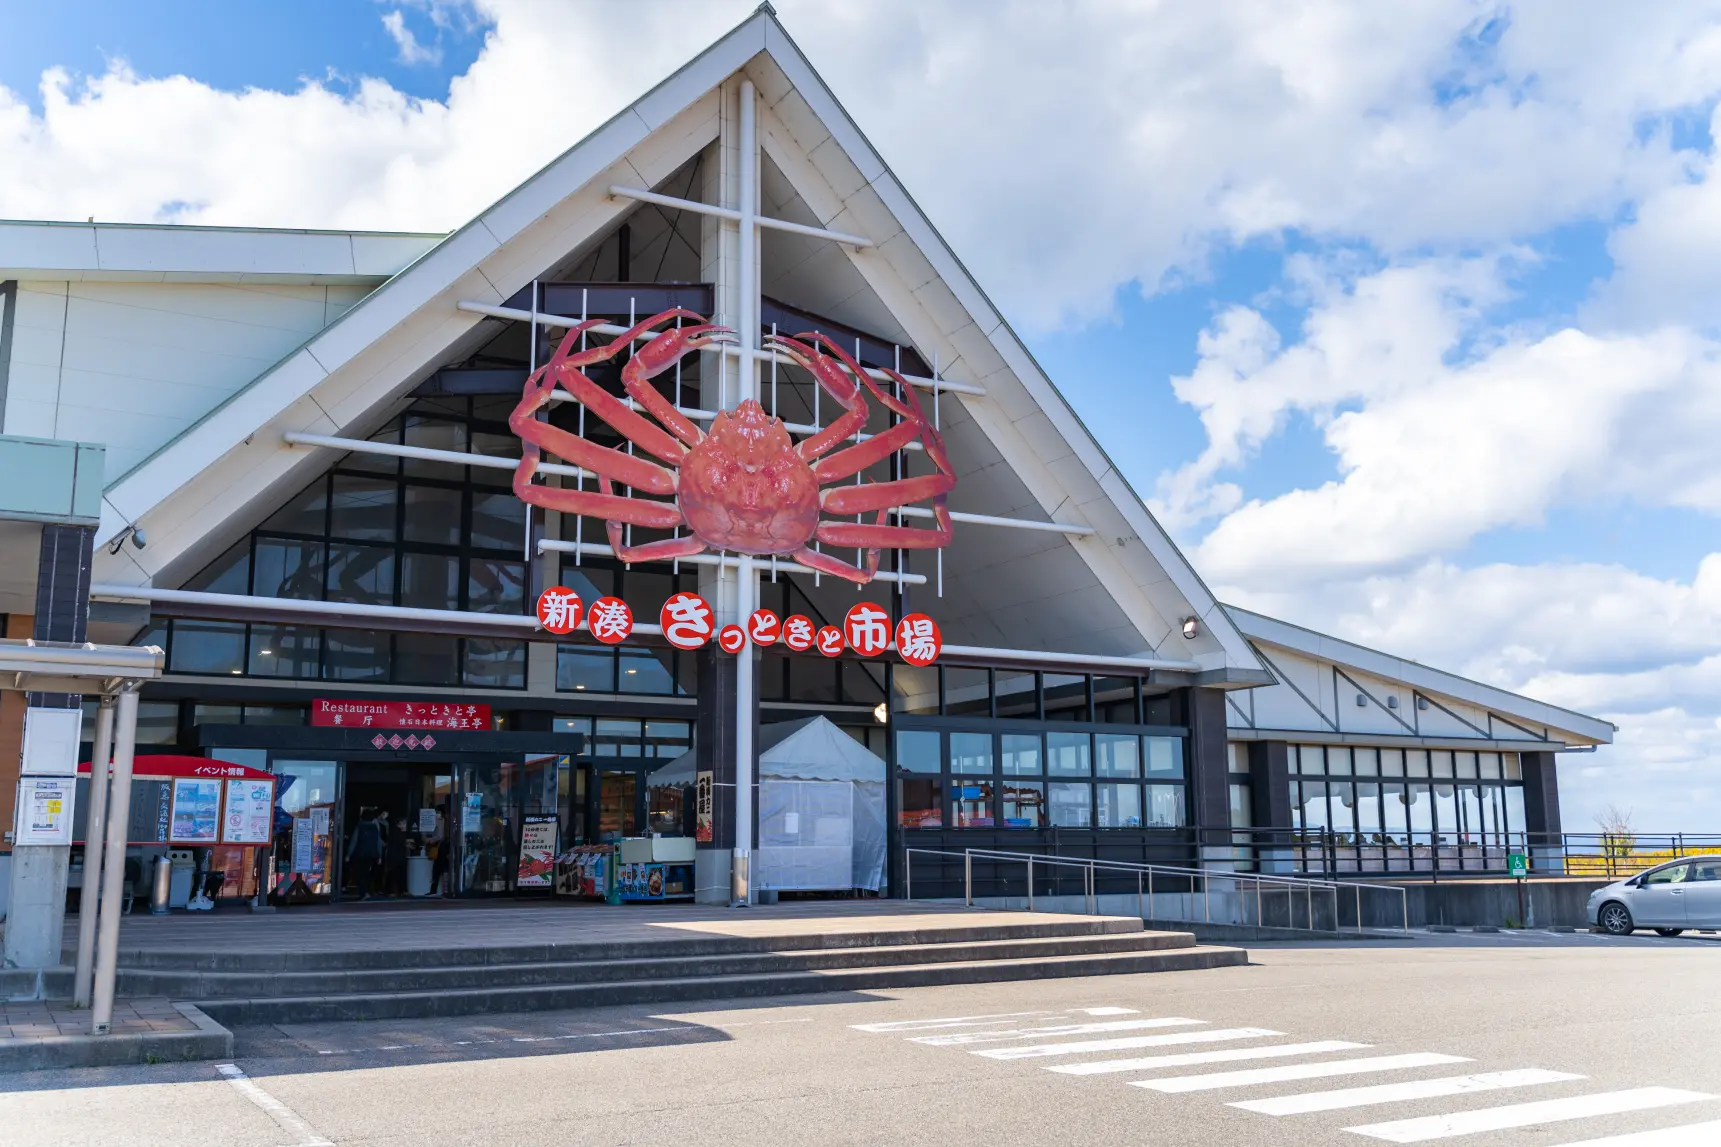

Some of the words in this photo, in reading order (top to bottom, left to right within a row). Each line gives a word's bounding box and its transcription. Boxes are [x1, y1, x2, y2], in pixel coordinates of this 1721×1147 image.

[321, 700, 388, 714] Restaurant
[405, 703, 477, 717] きっときと亭
[446, 717, 483, 729] 海王亭
[194, 766, 245, 776] イベント情報
